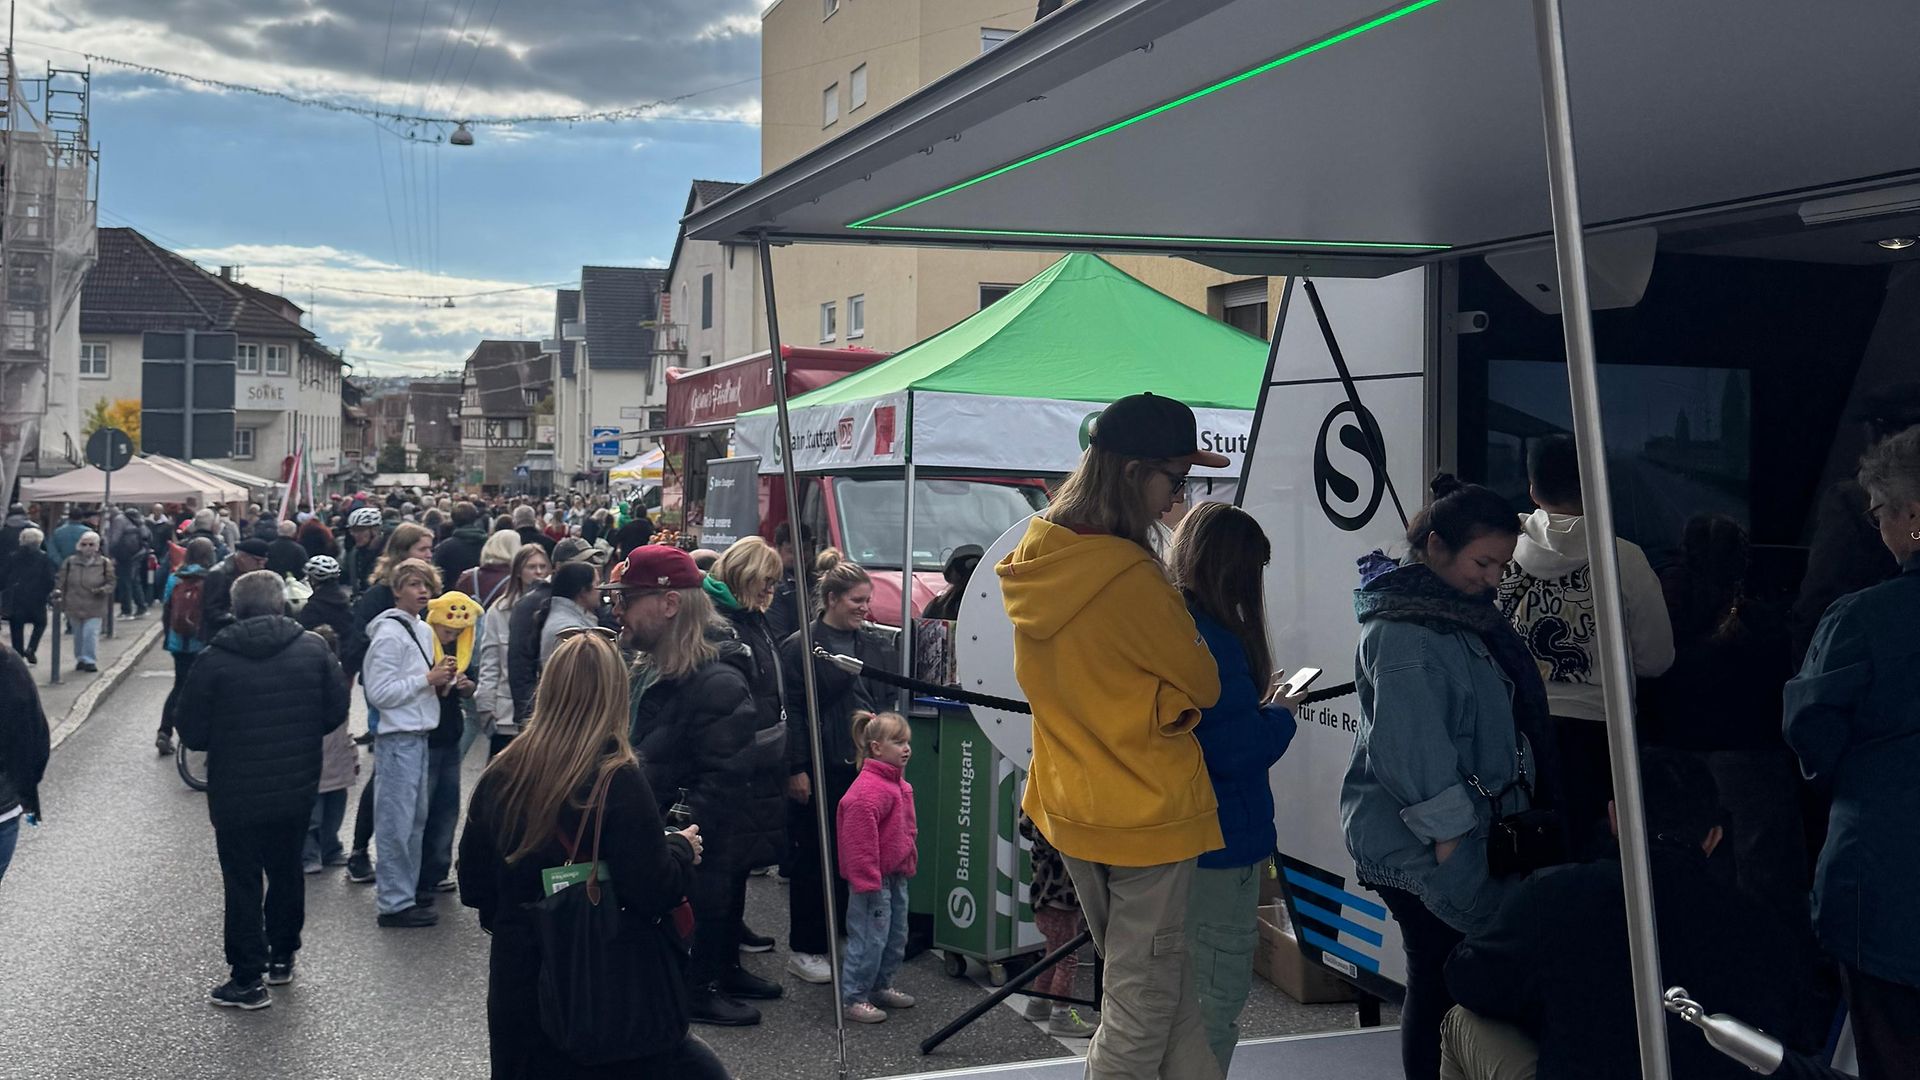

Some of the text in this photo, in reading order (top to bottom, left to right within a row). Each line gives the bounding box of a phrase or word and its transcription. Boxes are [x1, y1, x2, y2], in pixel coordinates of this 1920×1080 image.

[791, 430, 805, 450] ahn
[1201, 430, 1247, 453] Stut
[1298, 703, 1358, 733] für die Re
[958, 740, 975, 827] Stuttgart
[956, 832, 970, 881] Bahn
